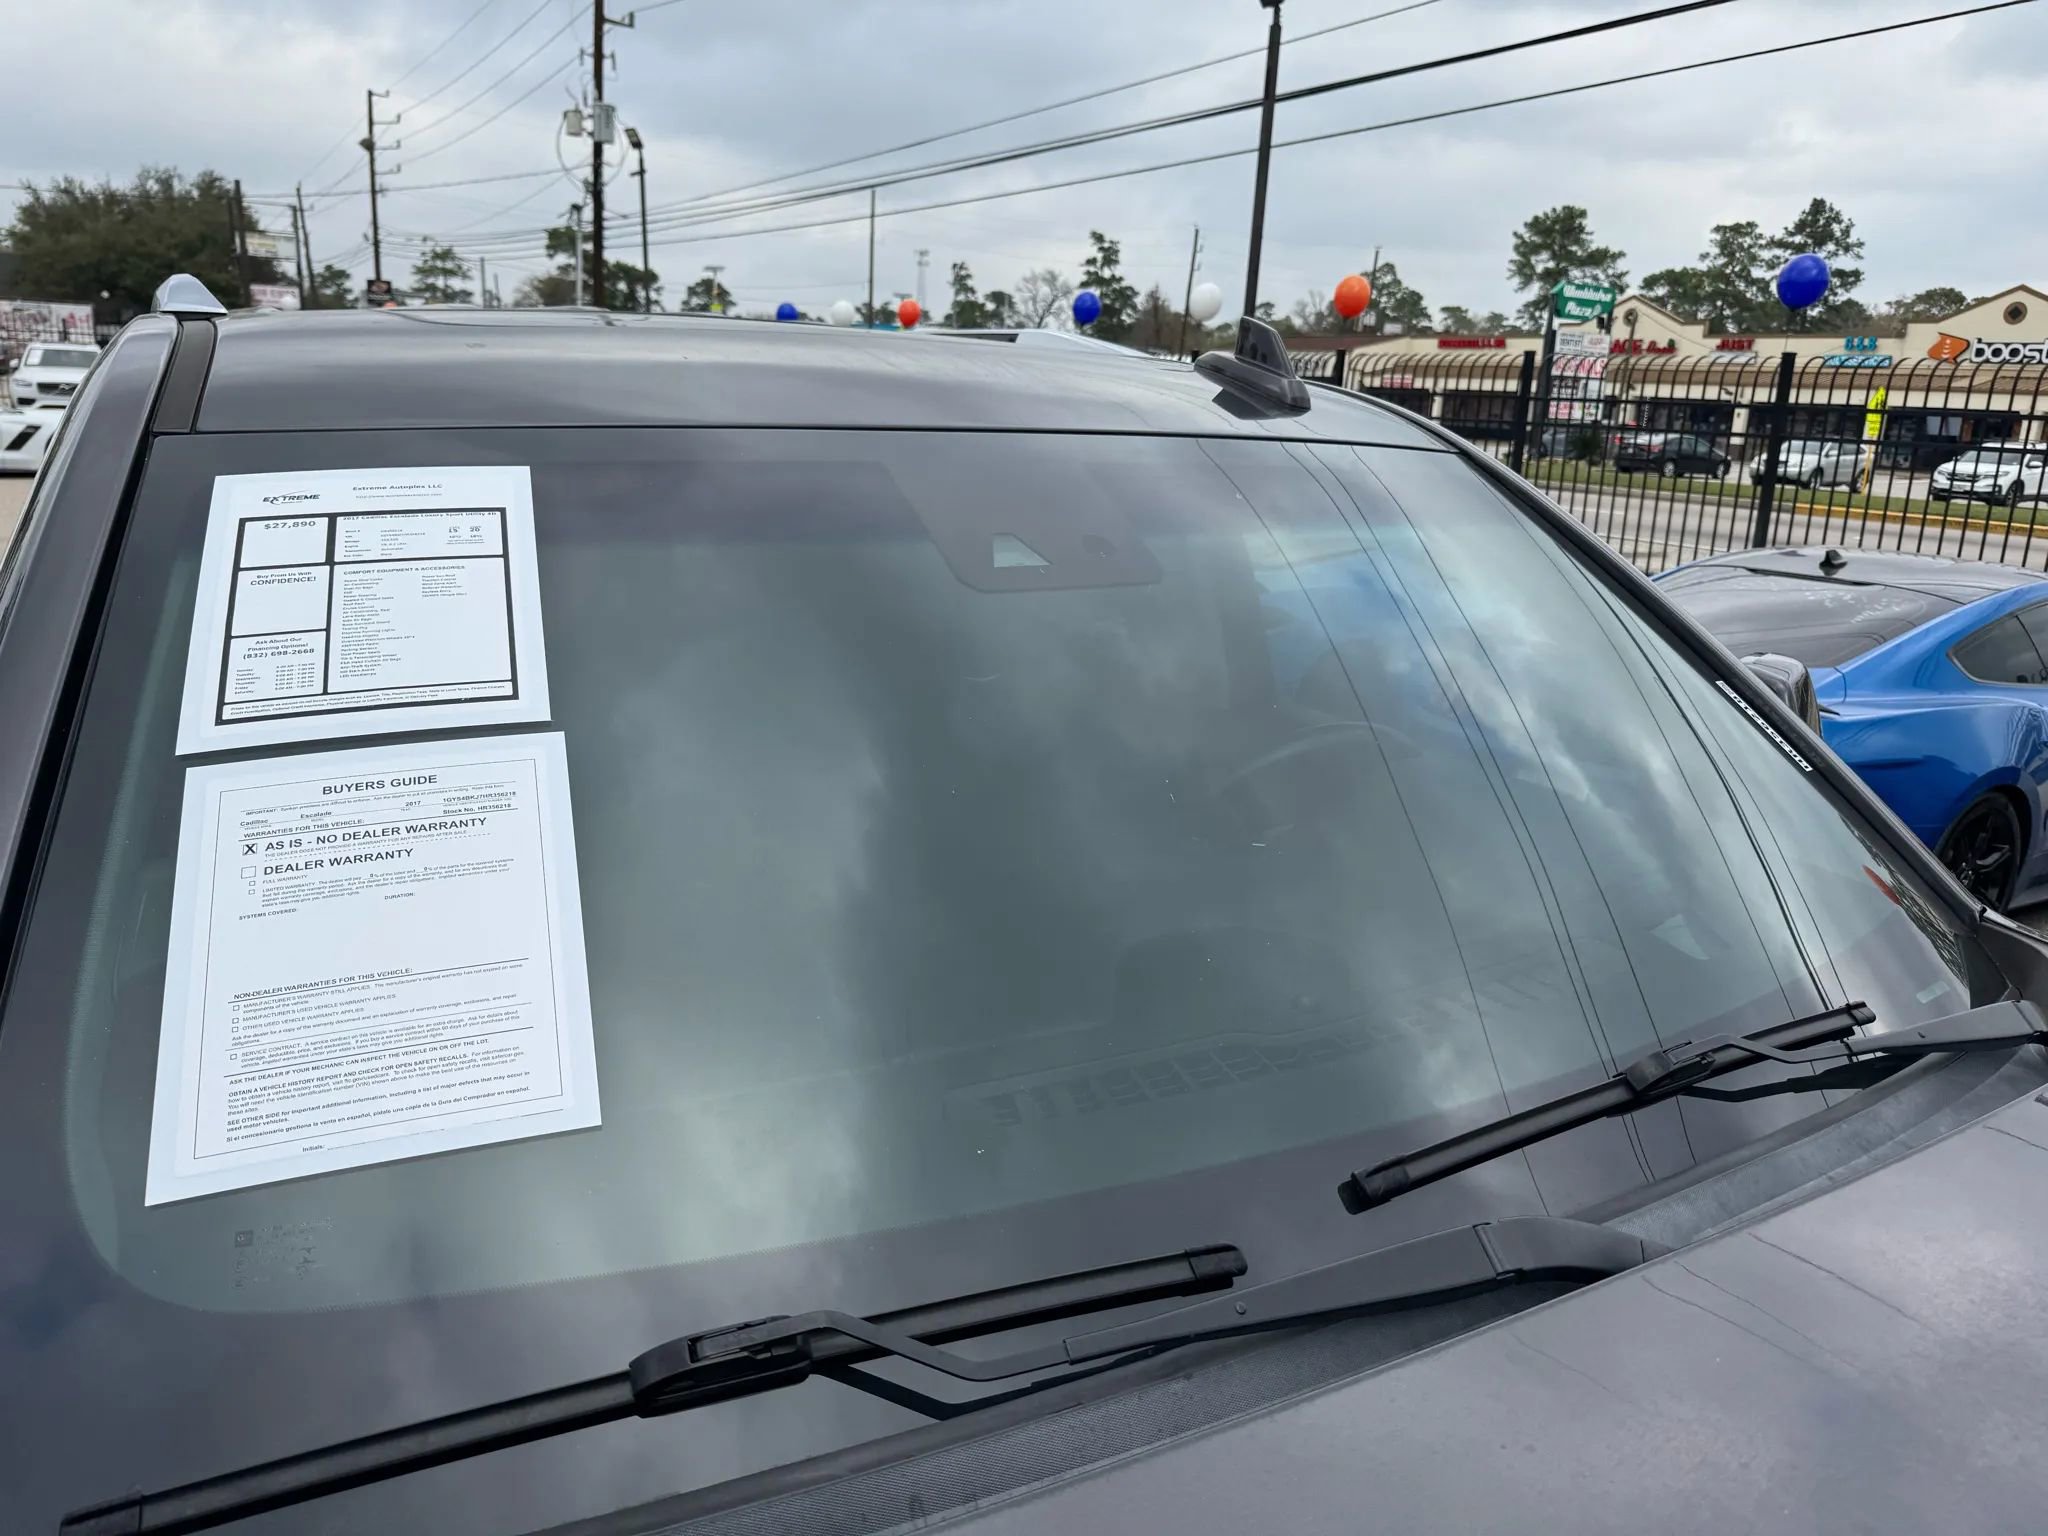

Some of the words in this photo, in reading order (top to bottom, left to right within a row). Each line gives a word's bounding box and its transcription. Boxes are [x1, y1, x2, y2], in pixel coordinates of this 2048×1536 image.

[1717, 337, 1755, 351] JUST
[1971, 338, 2048, 363] boost
[262, 494, 320, 503] EXTREME
[264, 521, 316, 530] $27,890
[250, 576, 317, 586] CONFIDENCE!
[243, 652, 268, 660] (832)
[270, 648, 315, 657] 698-2668
[322, 780, 386, 795] BUYERS
[390, 774, 438, 788] GUIDE
[240, 818, 269, 827] Cadillac
[300, 811, 332, 819] Escalade
[244, 828, 294, 839] WARRANTIES
[331, 819, 365, 828] VEHICLE:
[244, 843, 257, 855] X
[265, 840, 285, 852] AS
[289, 838, 303, 849] IS
[316, 834, 338, 845] NO
[342, 827, 401, 842] DEALER
[405, 817, 487, 835] WARRANTY
[264, 860, 324, 876] DEALER
[328, 848, 414, 868] WARRANTY
[384, 892, 416, 900] DURATION:
[239, 912, 267, 921] SYSTEMS
[234, 987, 283, 1000] NON-DEALER
[284, 979, 337, 992] WARRANTIES
[338, 976, 356, 984] FOR
[357, 973, 375, 981] THIS
[377, 967, 413, 978] VEHICLE:
[258, 1072, 284, 1080] DEALER
[292, 1067, 310, 1075] YOUR
[311, 1062, 345, 1071] MECHANIC
[360, 1055, 387, 1063] INSPECT
[401, 1048, 428, 1057] VEHICLE
[228, 1089, 253, 1098] OBTAIN
[259, 1083, 287, 1092] VEHICLE
[288, 1078, 314, 1087] HISTORY
[316, 1074, 342, 1082] REPORT
[358, 1067, 380, 1076] CHECK
[414, 1058, 438, 1066] SAFETY
[439, 1053, 469, 1062] RECALLS.
[241, 1115, 264, 1123] OTHER
[291, 1105, 321, 1116] important
[322, 1100, 351, 1109] additional
[389, 1089, 417, 1099] including
[226, 1125, 242, 1133] used
[243, 1122, 262, 1130] motor
[262, 1117, 290, 1126] vehicles.
